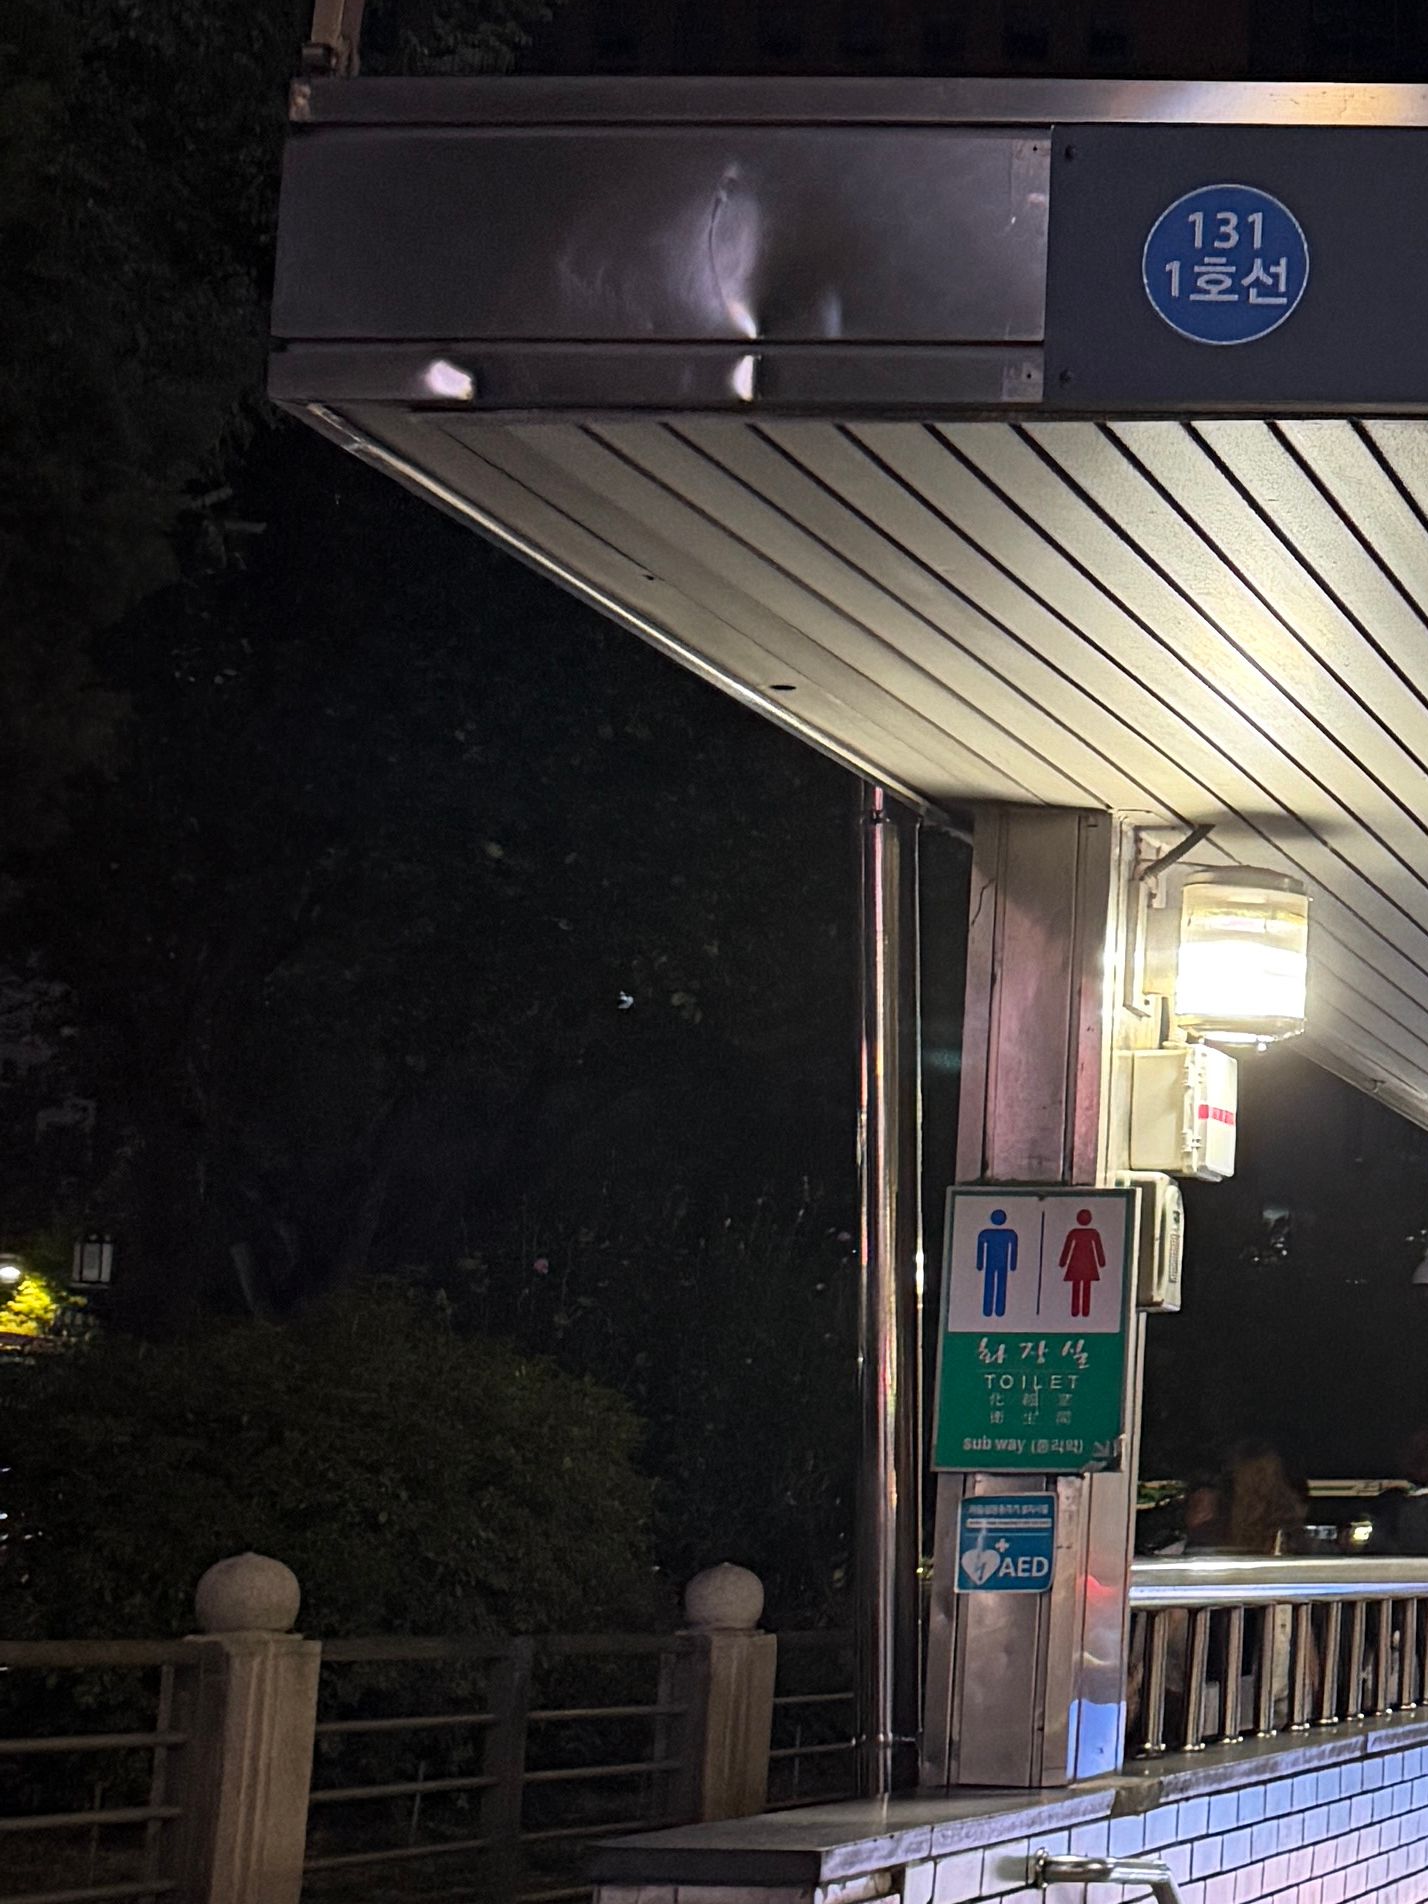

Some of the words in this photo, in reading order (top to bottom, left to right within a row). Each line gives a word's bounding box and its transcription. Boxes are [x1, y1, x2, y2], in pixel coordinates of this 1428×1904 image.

[1187, 211, 1265, 249] 131
[1163, 256, 1290, 306] 1호선
[985, 1375, 1079, 1390] TOILET
[999, 1557, 1050, 1577] AED
